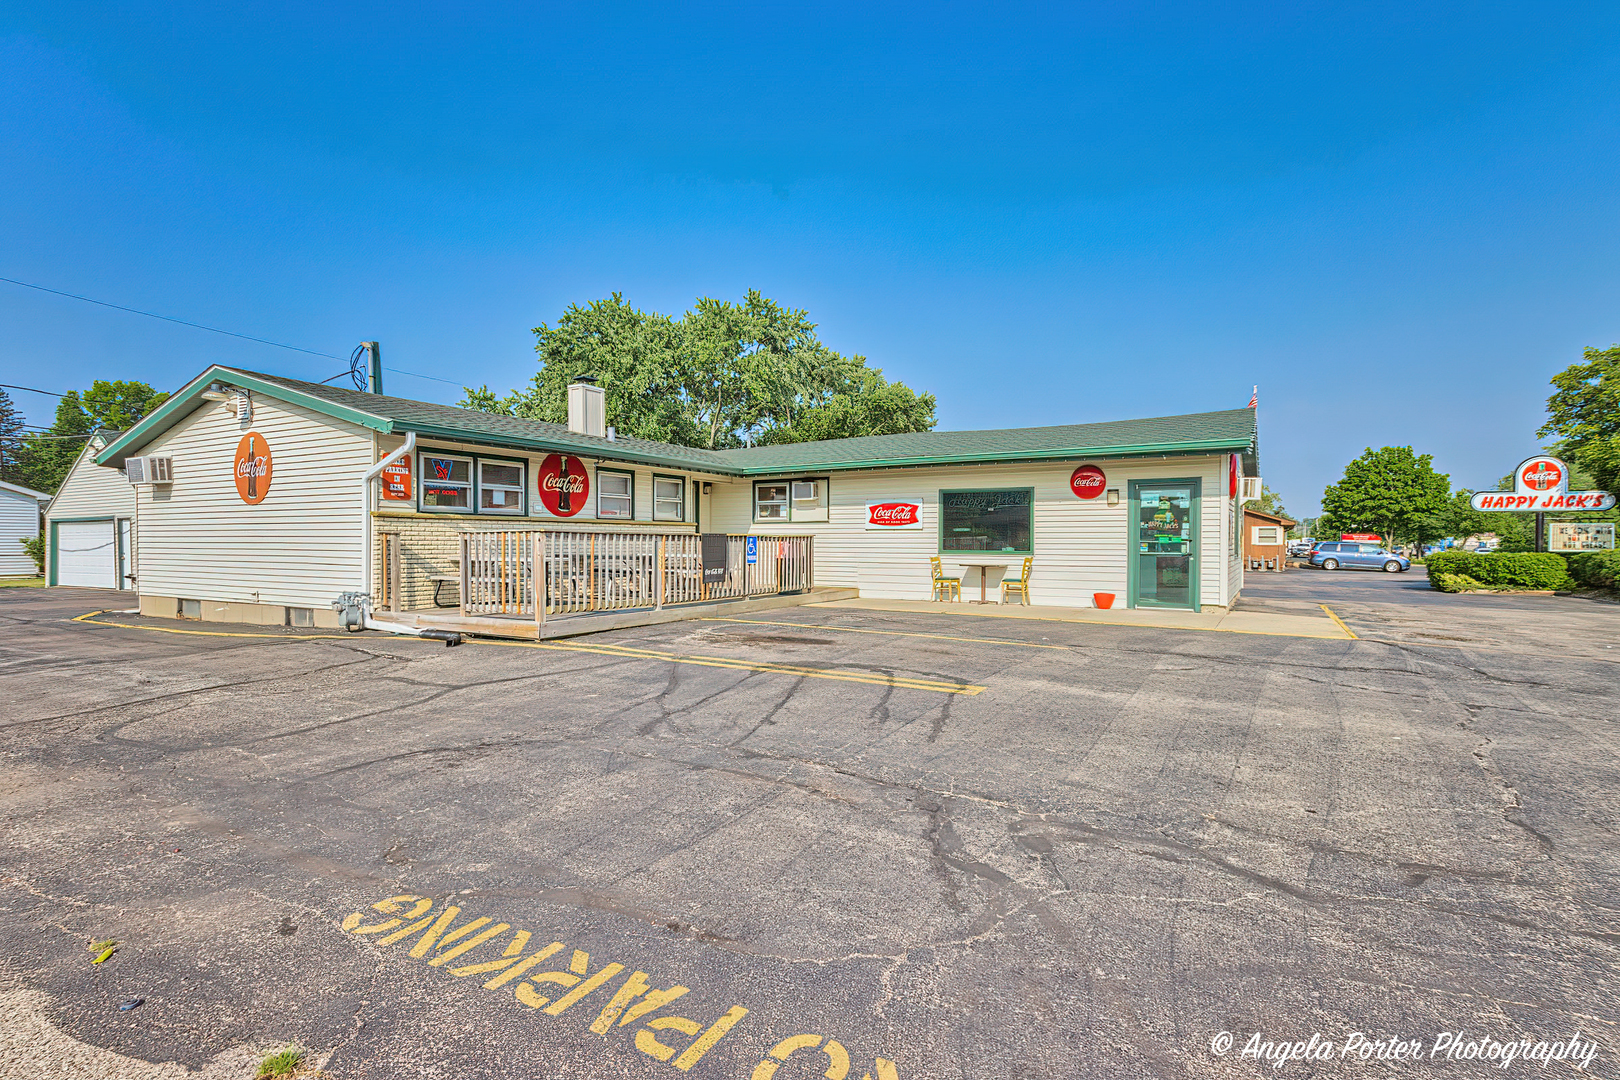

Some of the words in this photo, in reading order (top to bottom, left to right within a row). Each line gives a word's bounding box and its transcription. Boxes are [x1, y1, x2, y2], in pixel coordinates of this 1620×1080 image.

[385, 466, 409, 475] PARKING
[543, 472, 585, 494] Coca-Cola
[1480, 495, 1539, 509] HAPPY
[1541, 494, 1605, 508] JACK'S
[873, 506, 912, 520] Coca-Cola
[341, 895, 749, 1071] PARKING
